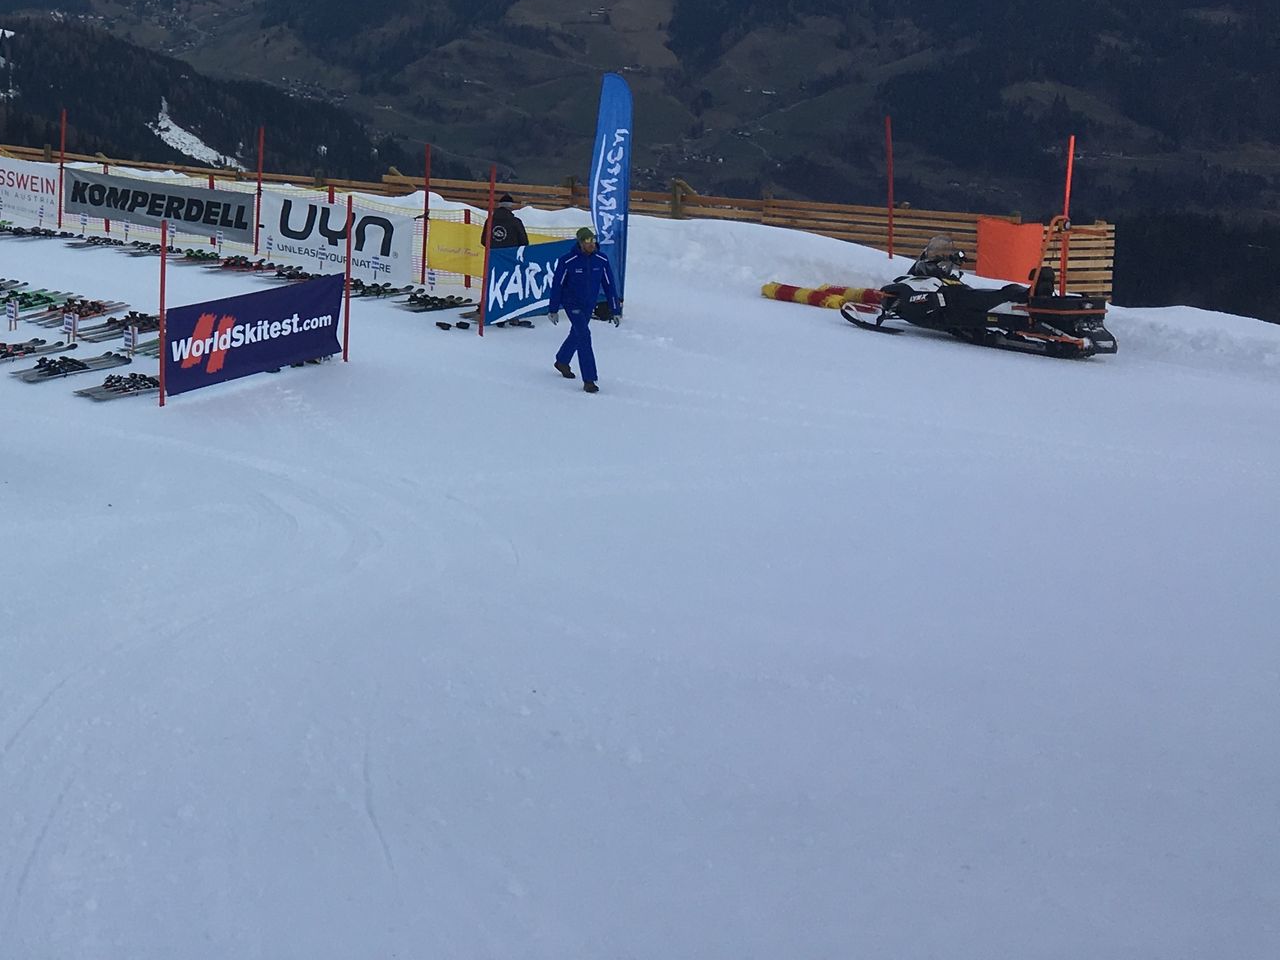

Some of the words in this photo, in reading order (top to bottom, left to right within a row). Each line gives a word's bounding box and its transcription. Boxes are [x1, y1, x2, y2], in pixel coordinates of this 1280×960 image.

[70, 180, 248, 230] KOMPERDELL
[351, 257, 391, 274] NATRE
[171, 313, 332, 363] WorldSkitest.com
